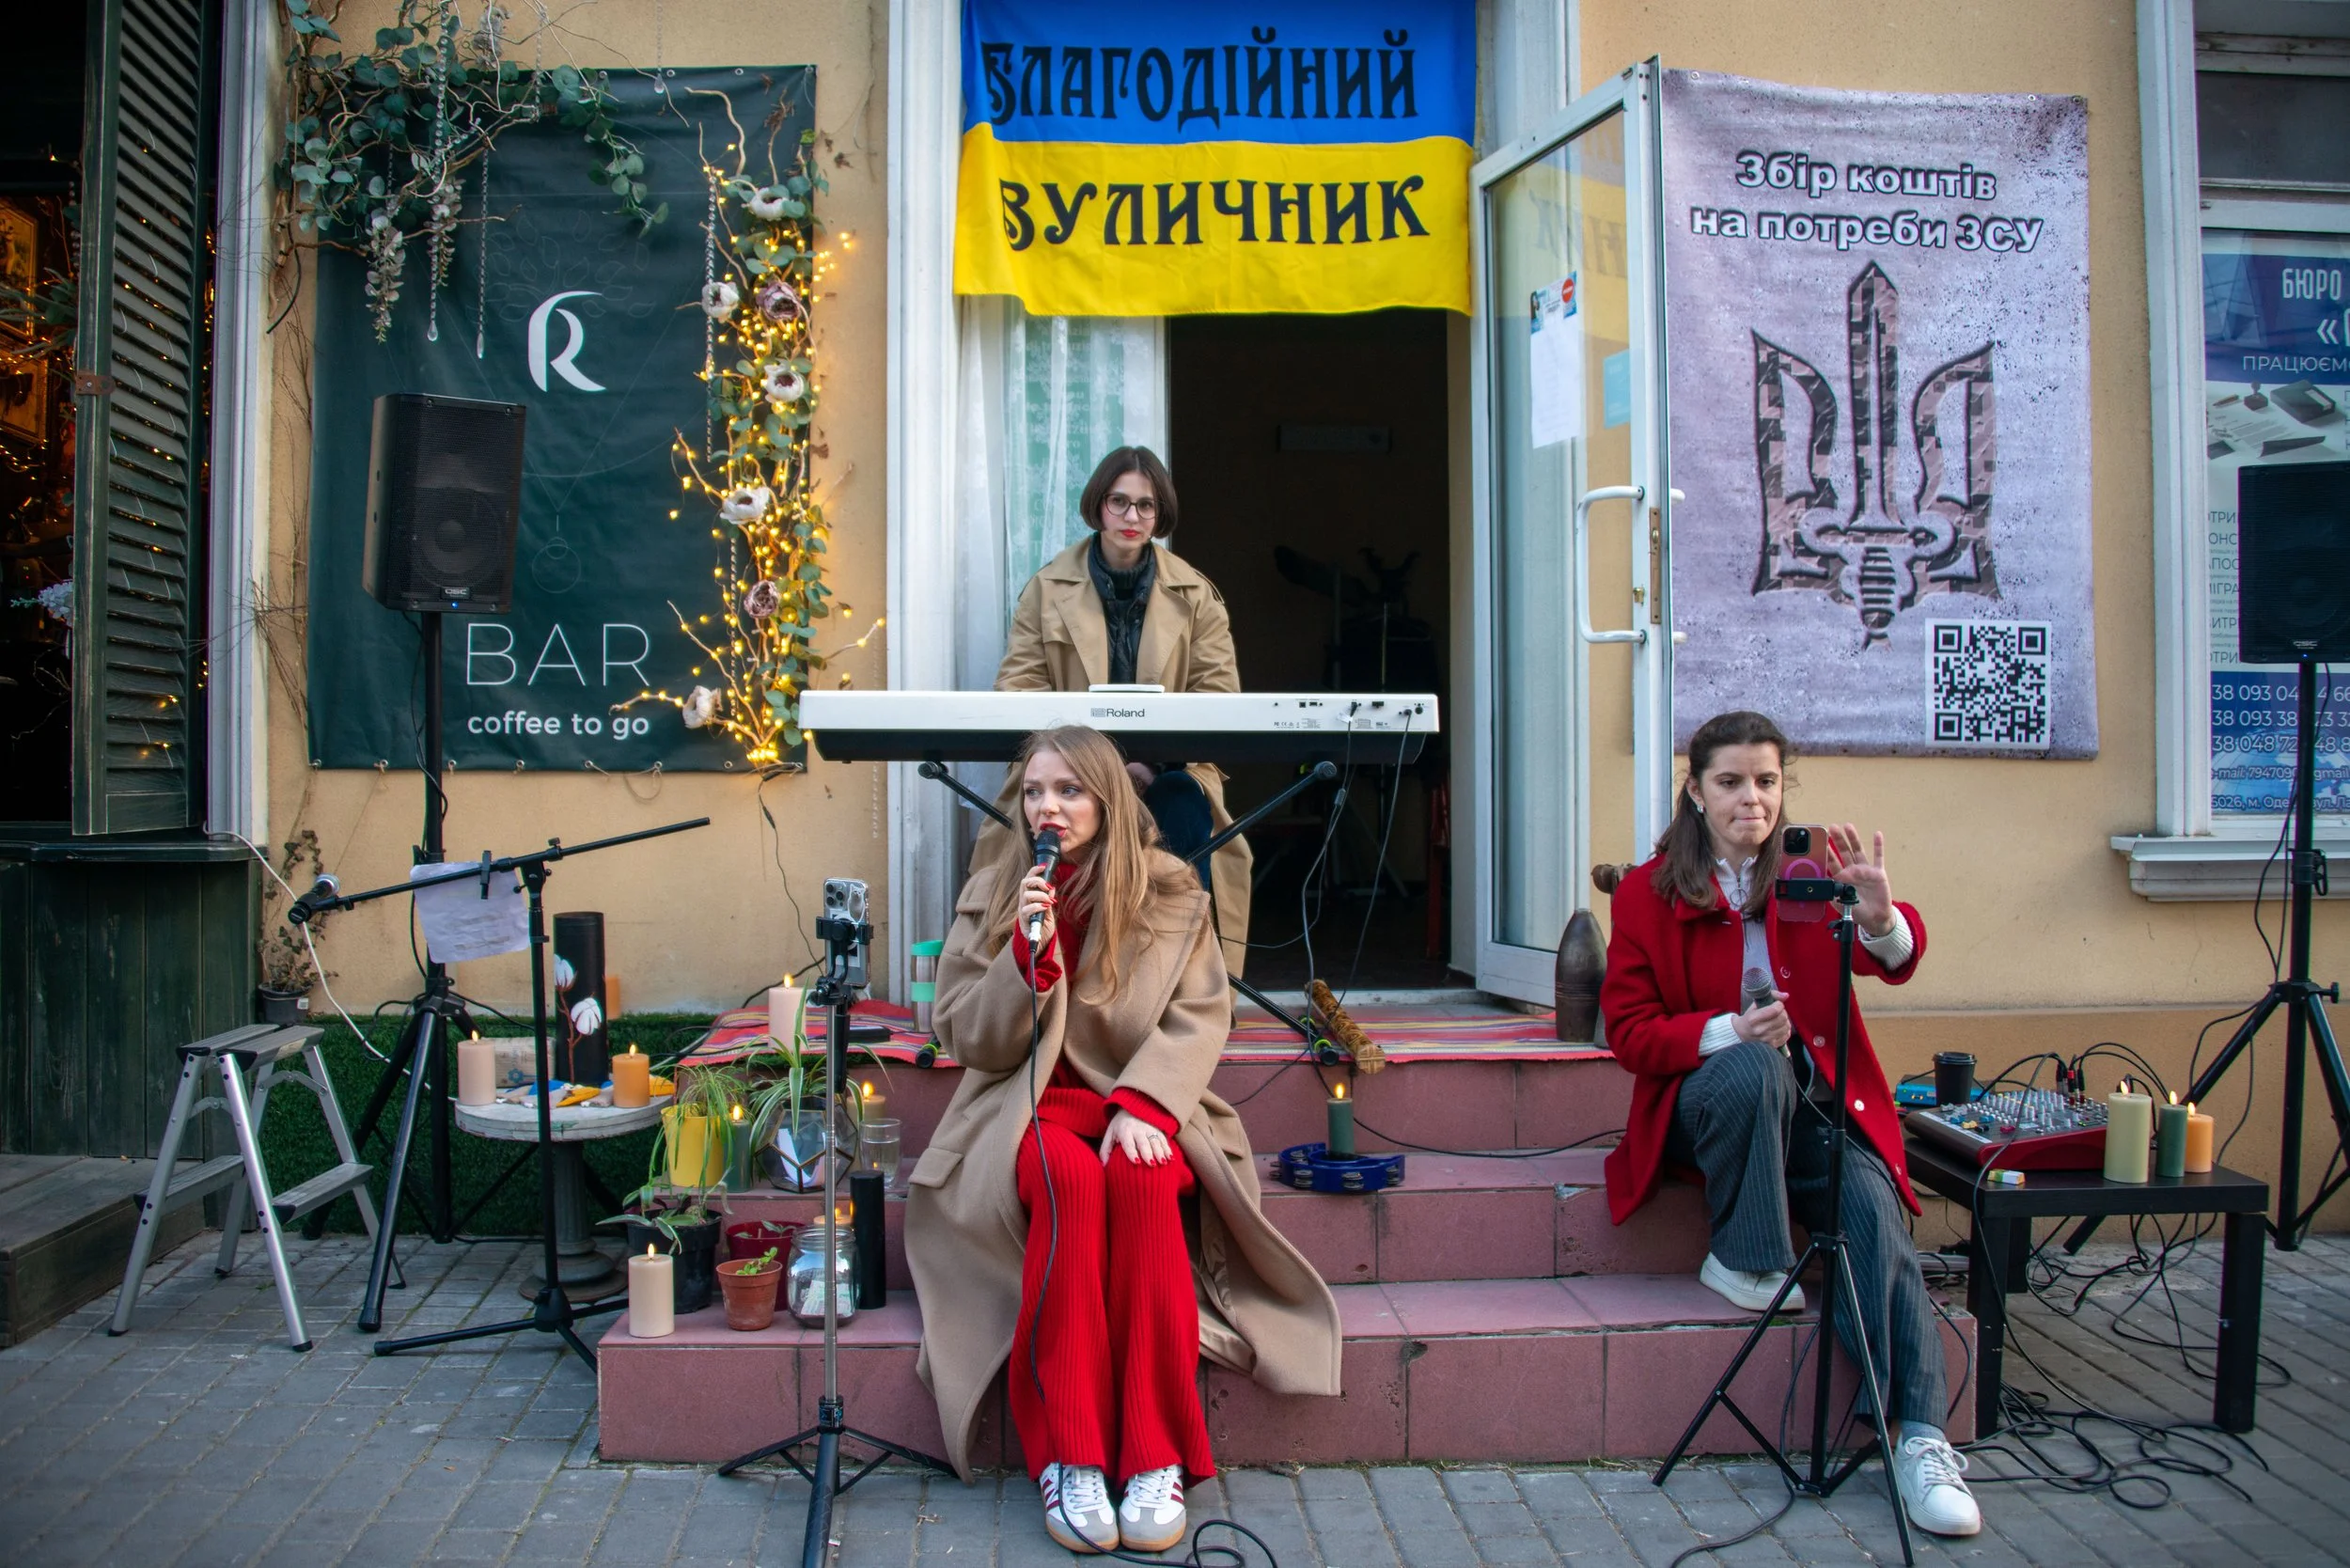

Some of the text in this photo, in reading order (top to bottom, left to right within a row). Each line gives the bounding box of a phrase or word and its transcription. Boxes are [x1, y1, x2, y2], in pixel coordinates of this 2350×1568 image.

[981, 25, 1418, 133] БЛАГОДІЙНИЙ
[1737, 149, 1997, 201] Збір коштів
[999, 175, 1430, 251] ВУЛИЧНИК
[1691, 207, 2044, 253] на потреби ЗСУ
[2282, 268, 2342, 301] БЮРО
[2243, 355, 2350, 373] ПРАЦЮЄМ
[2208, 511, 2236, 524] ТРИ
[2209, 557, 2239, 570] ПОС
[2210, 617, 2237, 629] ИТР
[466, 622, 650, 686] BAR
[2210, 651, 2238, 664] ТРИ
[2239, 684, 2272, 701] 093
[2276, 685, 2299, 701] 04
[1105, 708, 1145, 717] Roland
[2239, 710, 2272, 727] 093
[2277, 711, 2297, 727] 38
[468, 711, 650, 740] coffee to go
[2240, 736, 2275, 752] 048
[2280, 736, 2297, 751] 72
[2264, 796, 2289, 809] Оде
